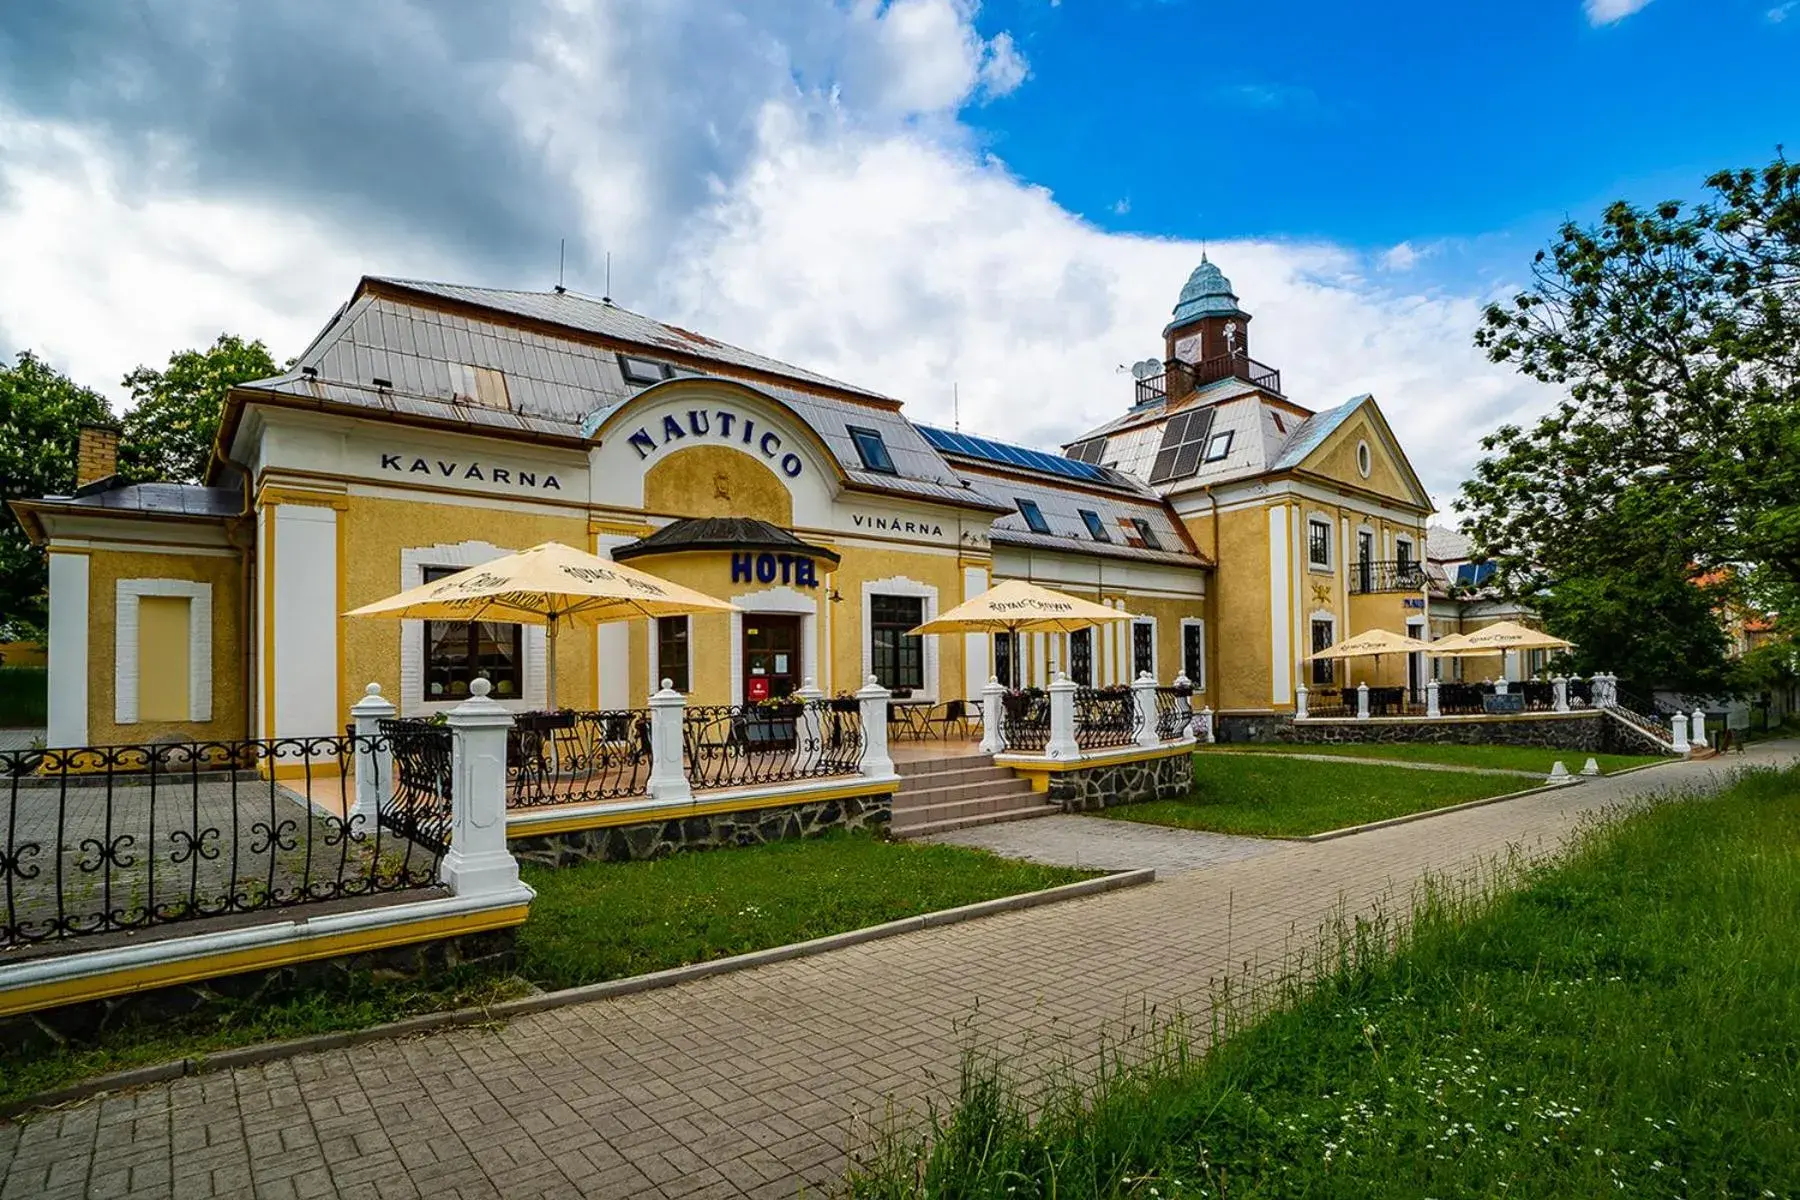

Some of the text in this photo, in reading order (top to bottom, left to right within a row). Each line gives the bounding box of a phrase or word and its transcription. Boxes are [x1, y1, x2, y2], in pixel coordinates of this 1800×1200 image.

[627, 408, 803, 478] NAUTICO
[381, 453, 561, 491] KAVÁRNA
[852, 514, 943, 535] VINÁRNA
[731, 552, 819, 588] HOTEL
